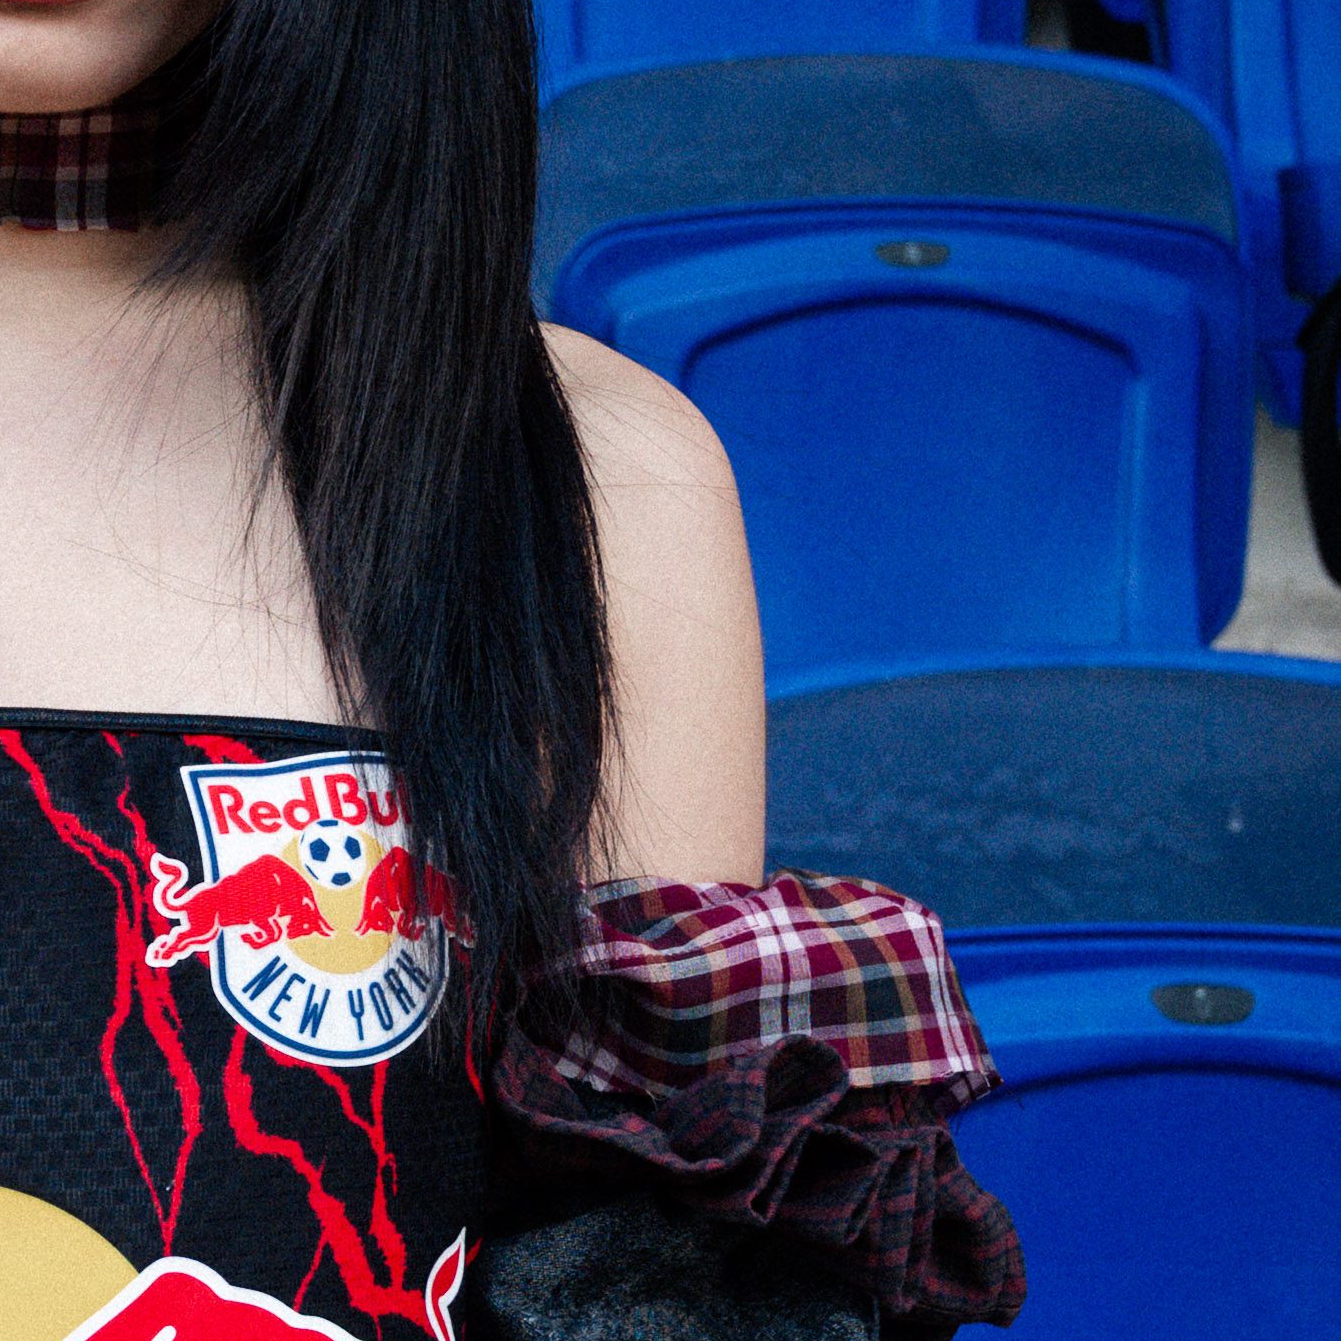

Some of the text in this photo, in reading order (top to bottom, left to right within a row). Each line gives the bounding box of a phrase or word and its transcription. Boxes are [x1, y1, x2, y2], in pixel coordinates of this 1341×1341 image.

[208, 768, 412, 835] Red Bul
[242, 949, 431, 1041] NEW YORK
